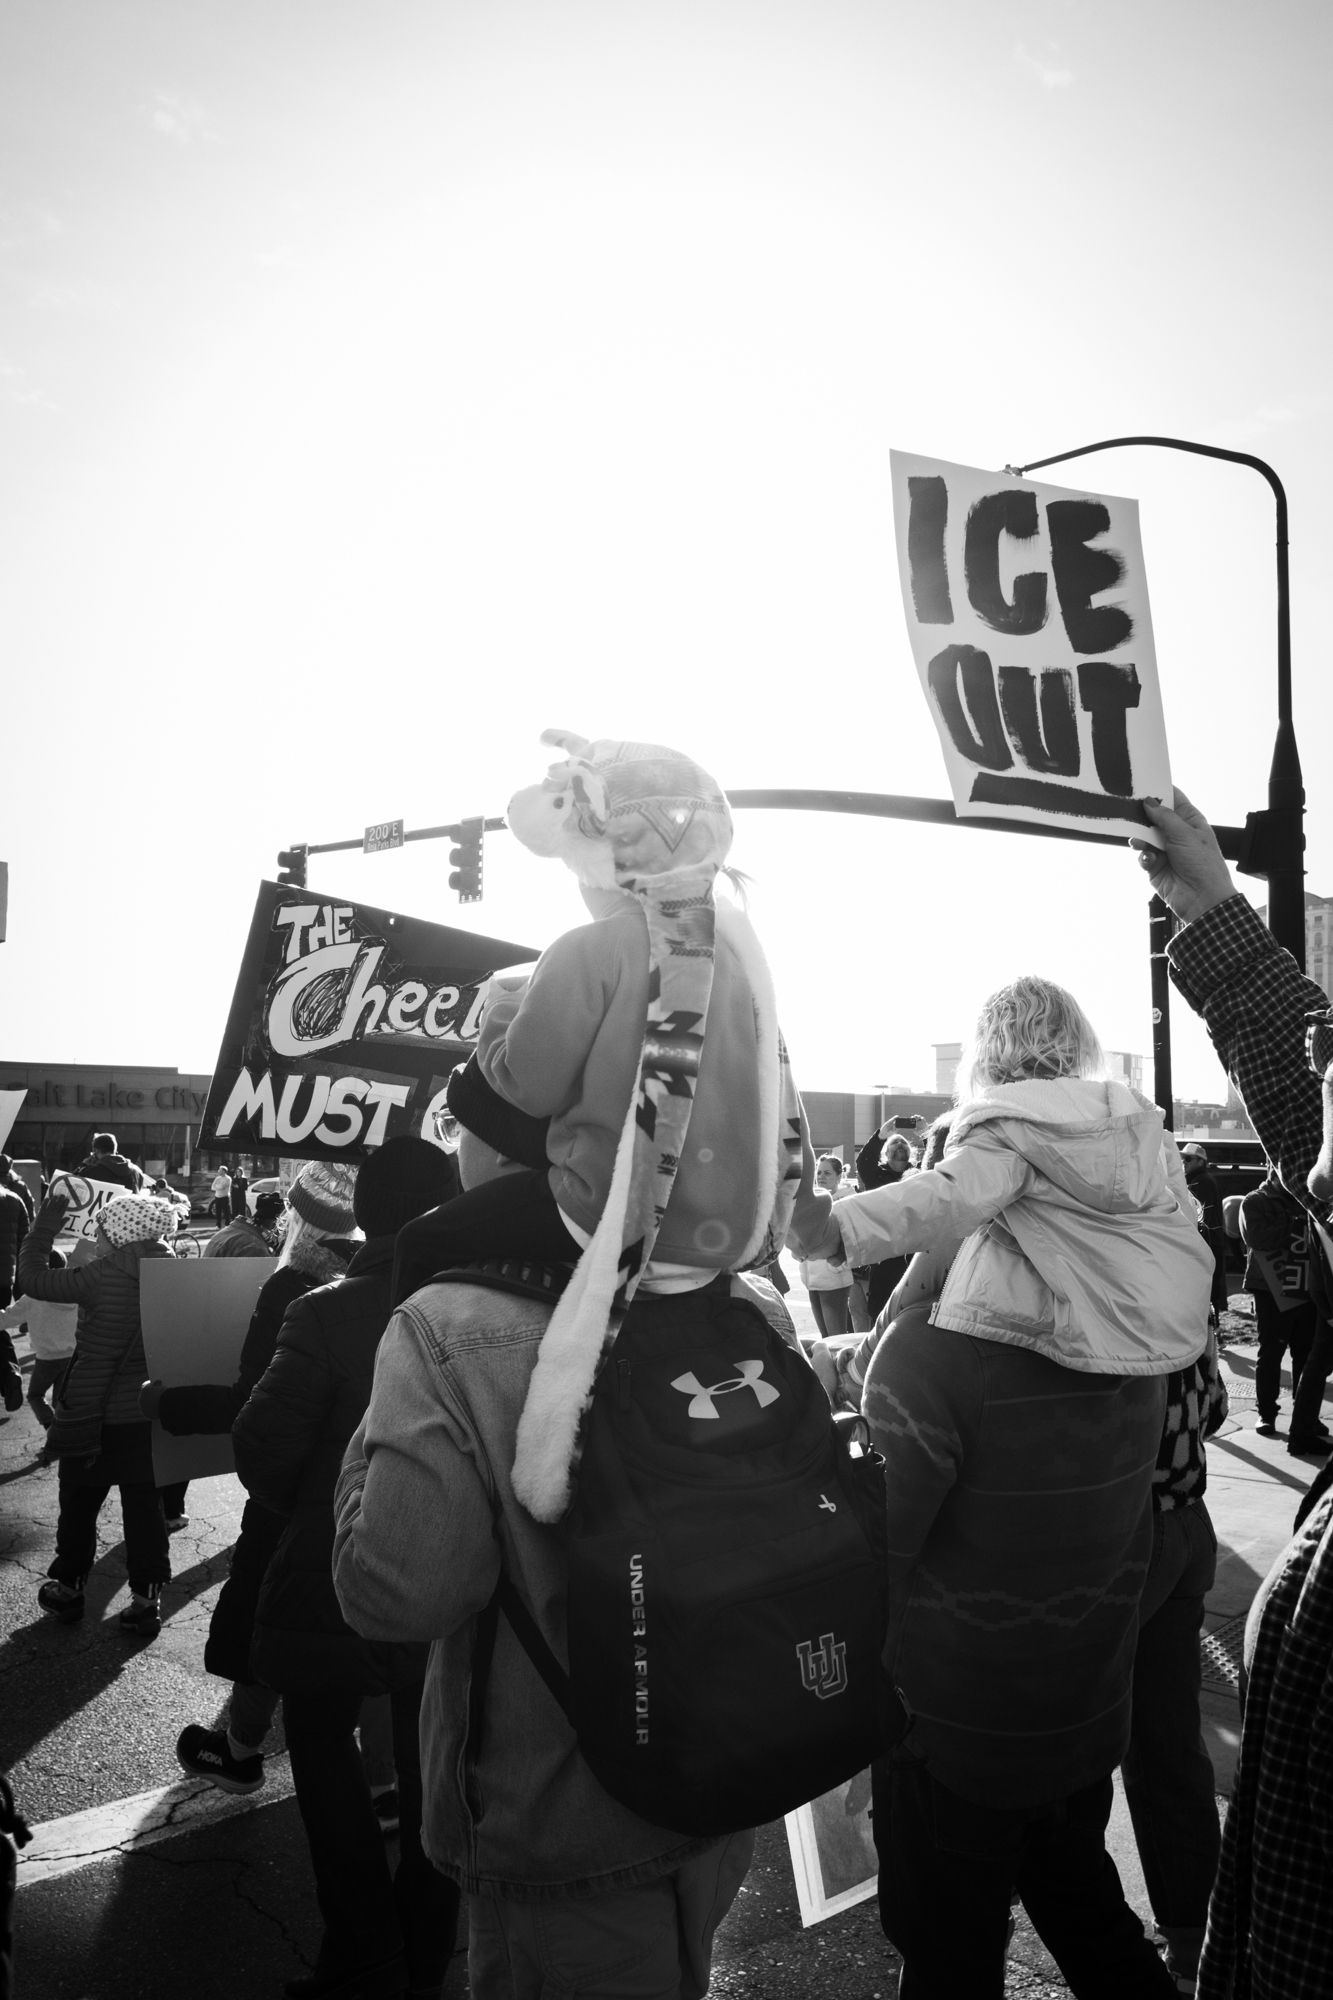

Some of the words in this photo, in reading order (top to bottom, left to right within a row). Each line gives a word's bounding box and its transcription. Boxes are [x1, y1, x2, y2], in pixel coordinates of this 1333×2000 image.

[907, 475, 1134, 654] ICE
[928, 644, 1141, 797] OUT
[369, 824, 389, 841] 200
[393, 822, 399, 836] E
[276, 904, 354, 964] THE
[77, 1082, 144, 1109] Lake
[216, 1067, 410, 1148] MUST
[630, 1553, 646, 1637] UNDER
[634, 1643, 650, 1746] ARMOUR
